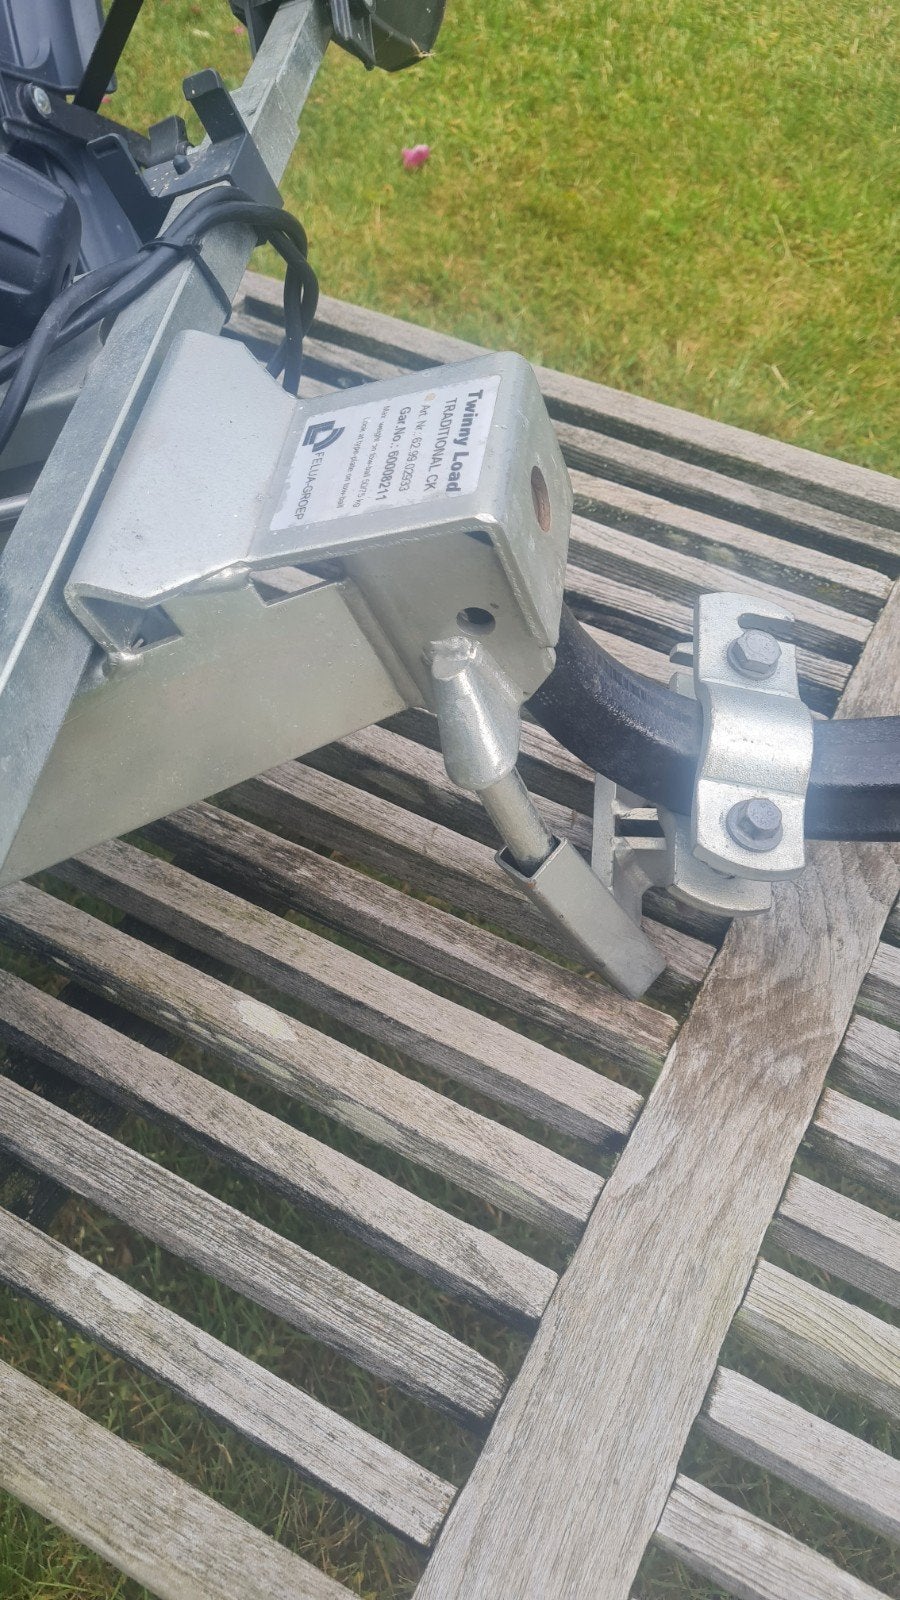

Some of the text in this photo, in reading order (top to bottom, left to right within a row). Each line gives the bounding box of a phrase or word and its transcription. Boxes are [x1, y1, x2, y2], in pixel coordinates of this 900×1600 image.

[376, 450, 399, 501] 60008211
[424, 397, 457, 492] TRADITIONAL CK
[446, 389, 483, 492] Twinny Load
[294, 451, 325, 521] FELUA-GROEP
